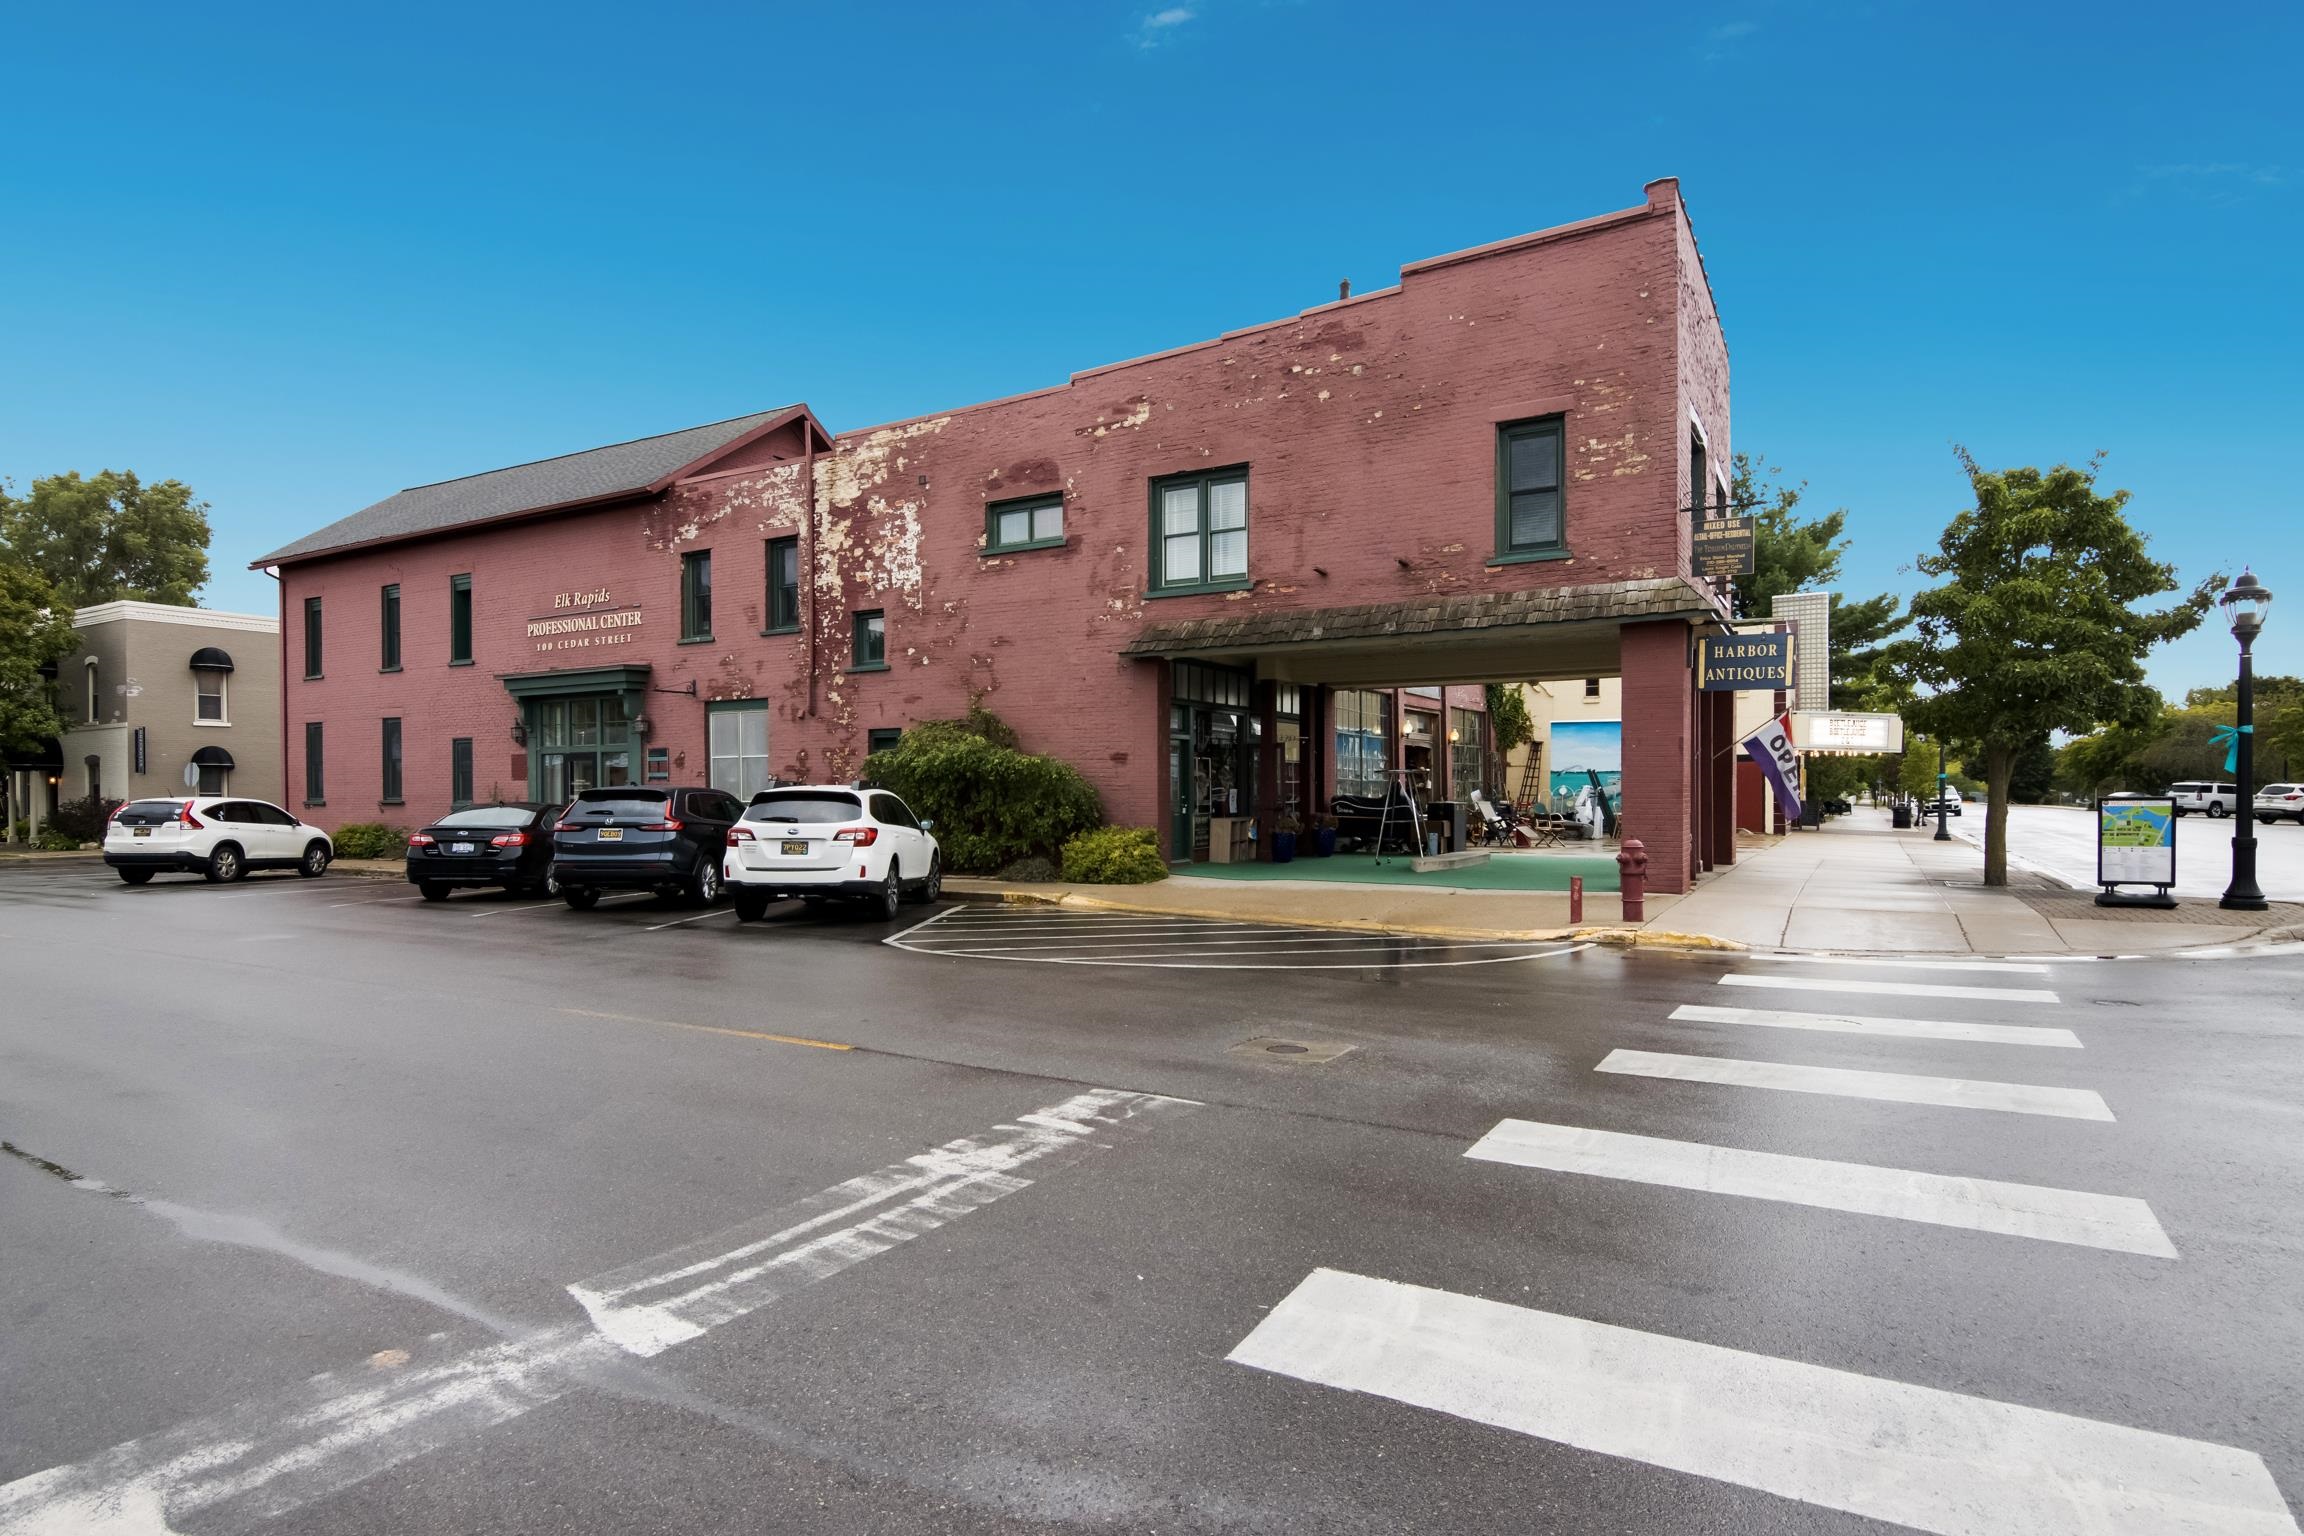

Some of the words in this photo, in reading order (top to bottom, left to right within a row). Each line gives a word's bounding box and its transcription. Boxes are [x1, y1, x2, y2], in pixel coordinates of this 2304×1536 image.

[1704, 521, 1725, 530] MIXED
[1728, 520, 1741, 528] USE
[554, 595, 571, 608] Elk
[573, 588, 610, 609] Rapids
[527, 616, 599, 637] PROFESSIONAL
[600, 611, 642, 629] CENTER
[536, 642, 553, 651] 100
[558, 639, 590, 650] CEDAR
[595, 633, 632, 646] STREET
[1714, 643, 1777, 658] HARBOR
[1705, 666, 1785, 682] ANTIQUES
[1770, 734, 1799, 792] OPE
